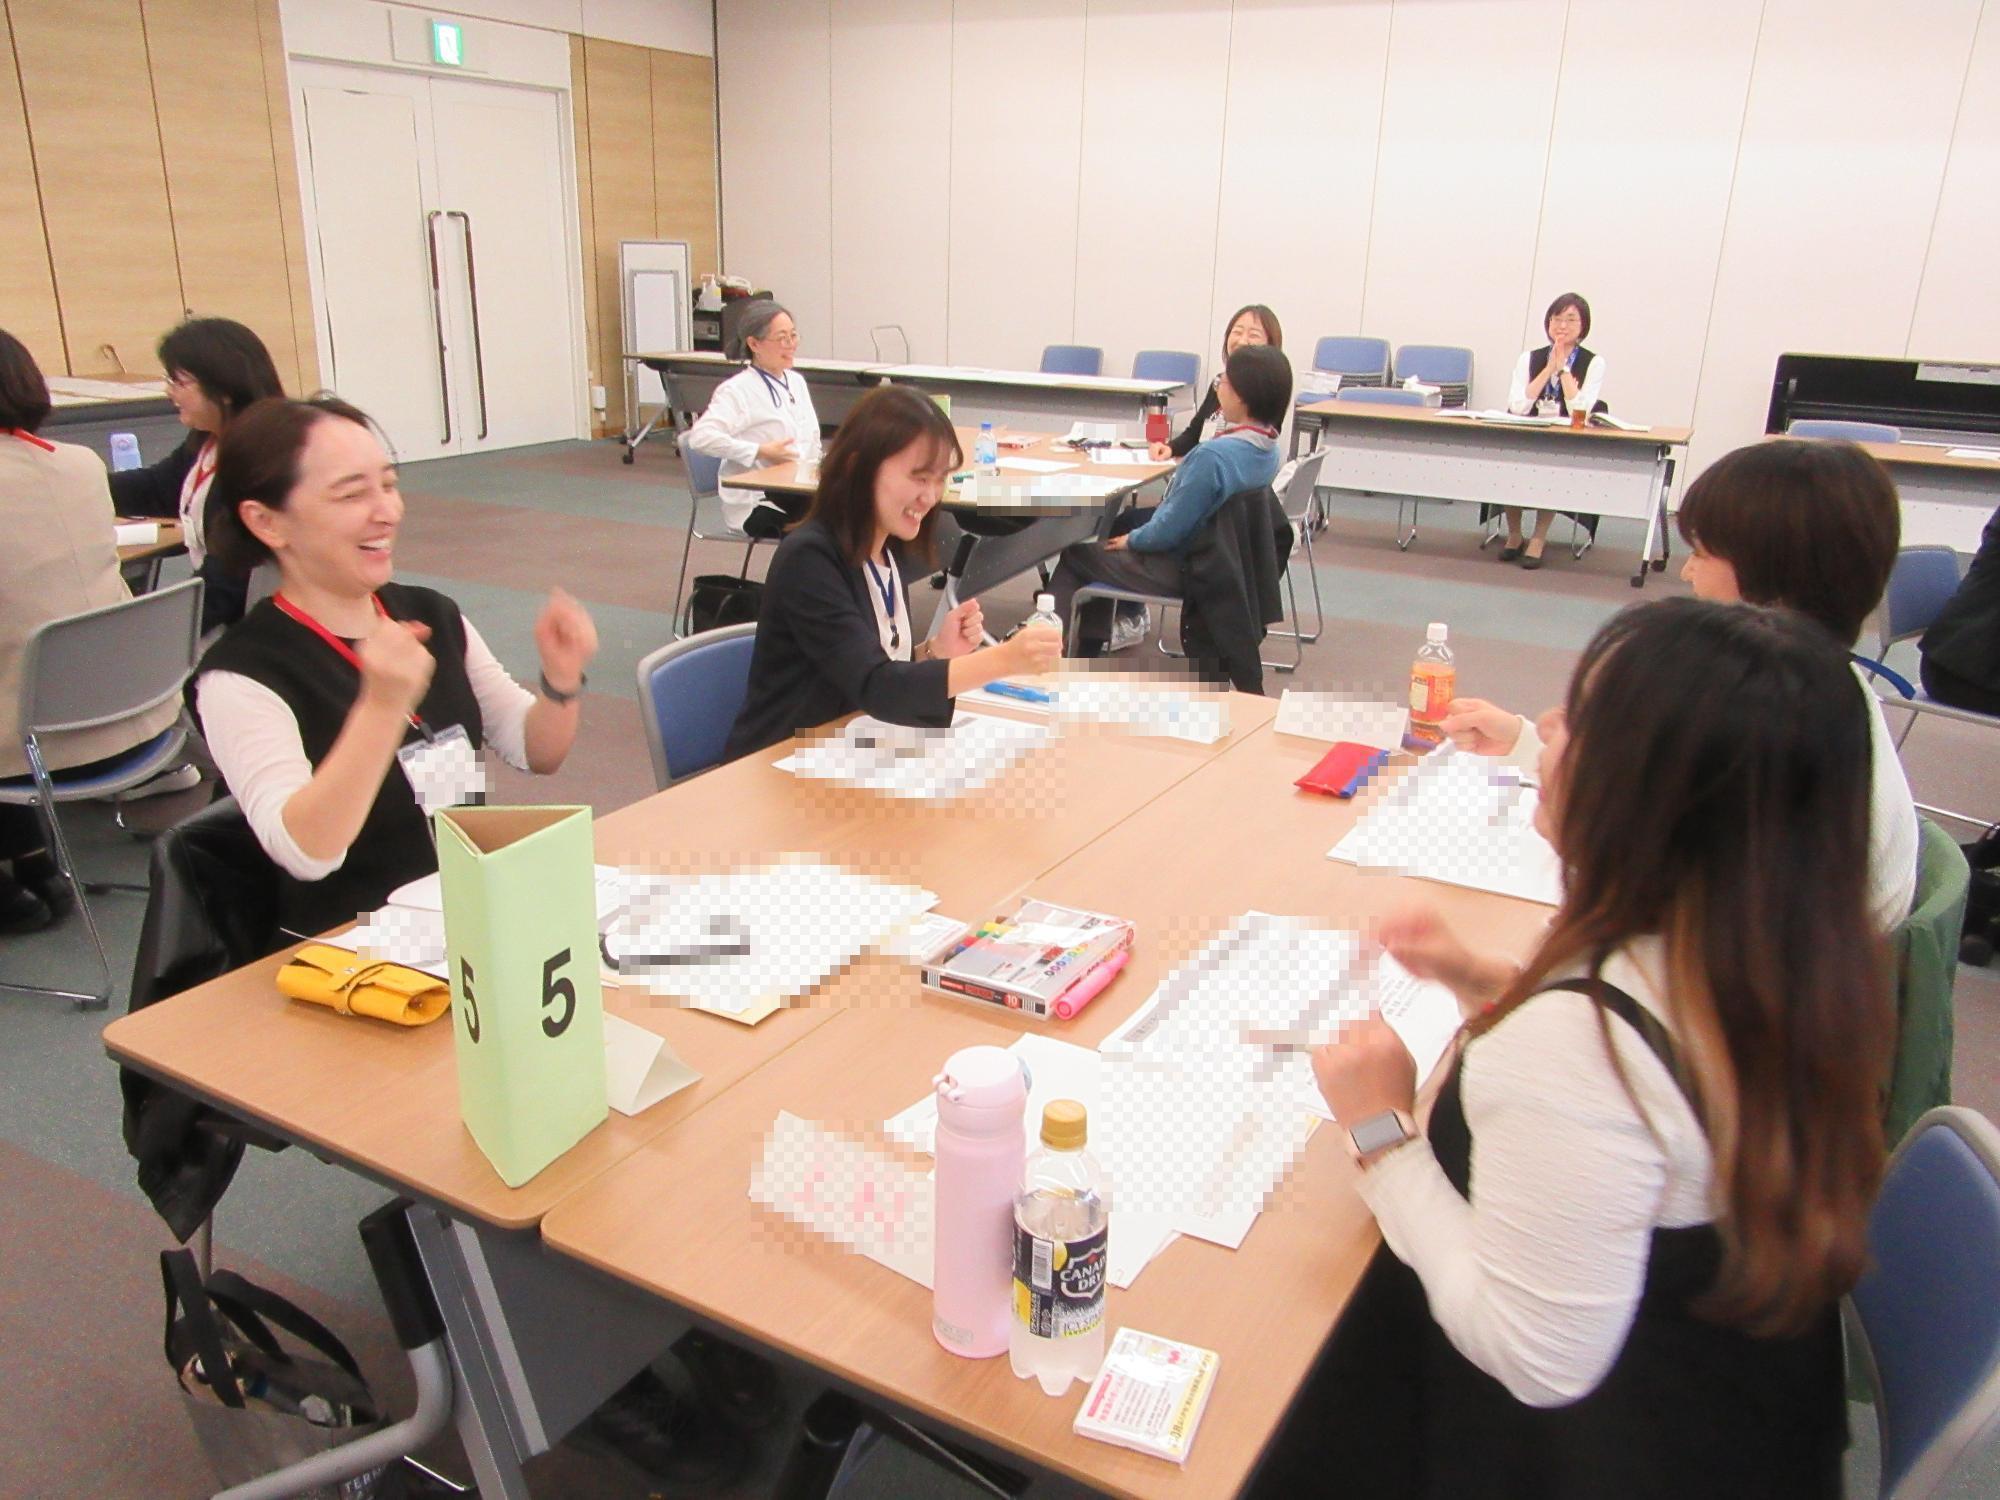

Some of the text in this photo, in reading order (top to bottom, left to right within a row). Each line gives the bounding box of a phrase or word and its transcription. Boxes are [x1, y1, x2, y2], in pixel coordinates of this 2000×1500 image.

[460, 956, 480, 1044] 5
[541, 947, 576, 1038] 5
[1006, 994, 1018, 1005] 10
